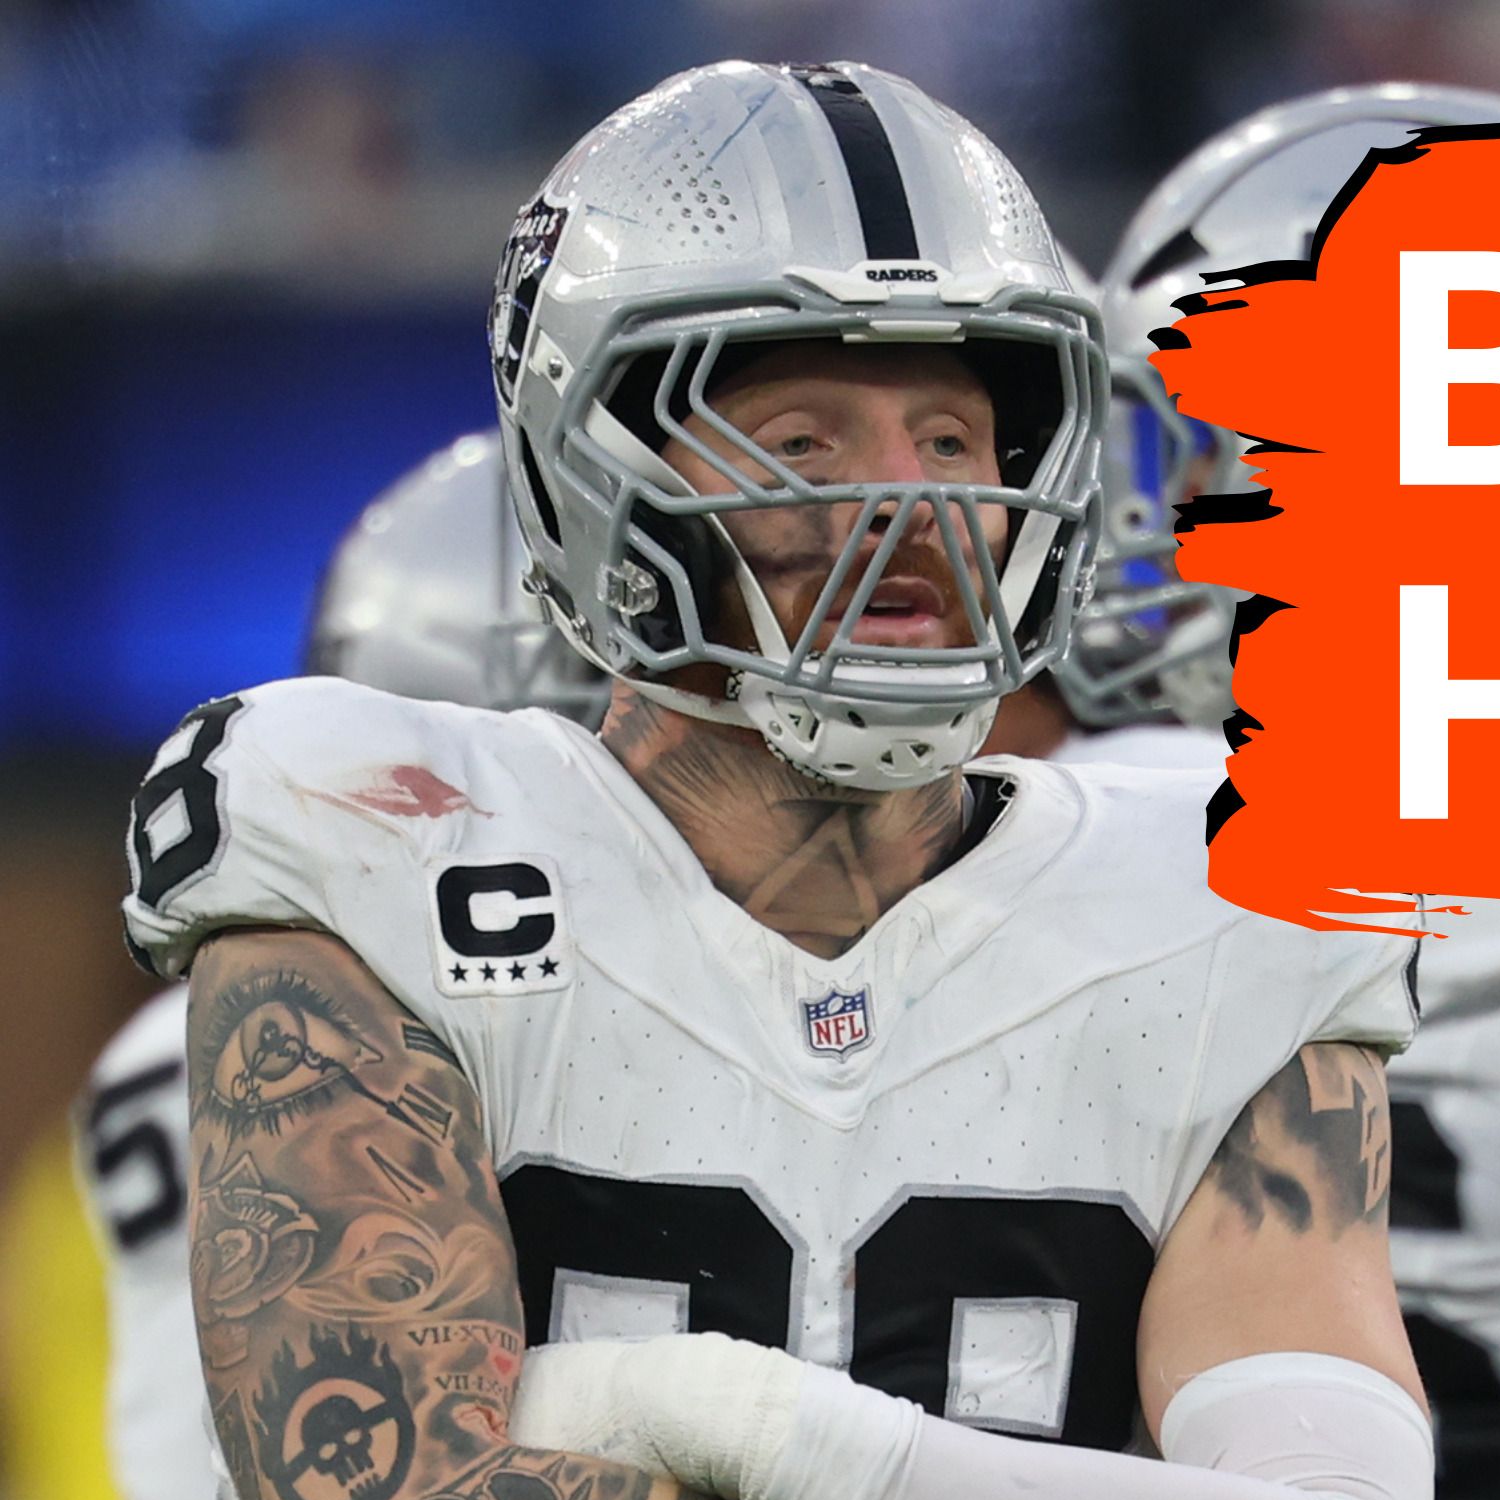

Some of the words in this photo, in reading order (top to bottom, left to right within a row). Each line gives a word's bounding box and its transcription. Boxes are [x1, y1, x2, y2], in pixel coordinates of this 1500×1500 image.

[865, 269, 938, 282] RAIDERS
[436, 862, 556, 958] C
[814, 1014, 864, 1046] NFL
